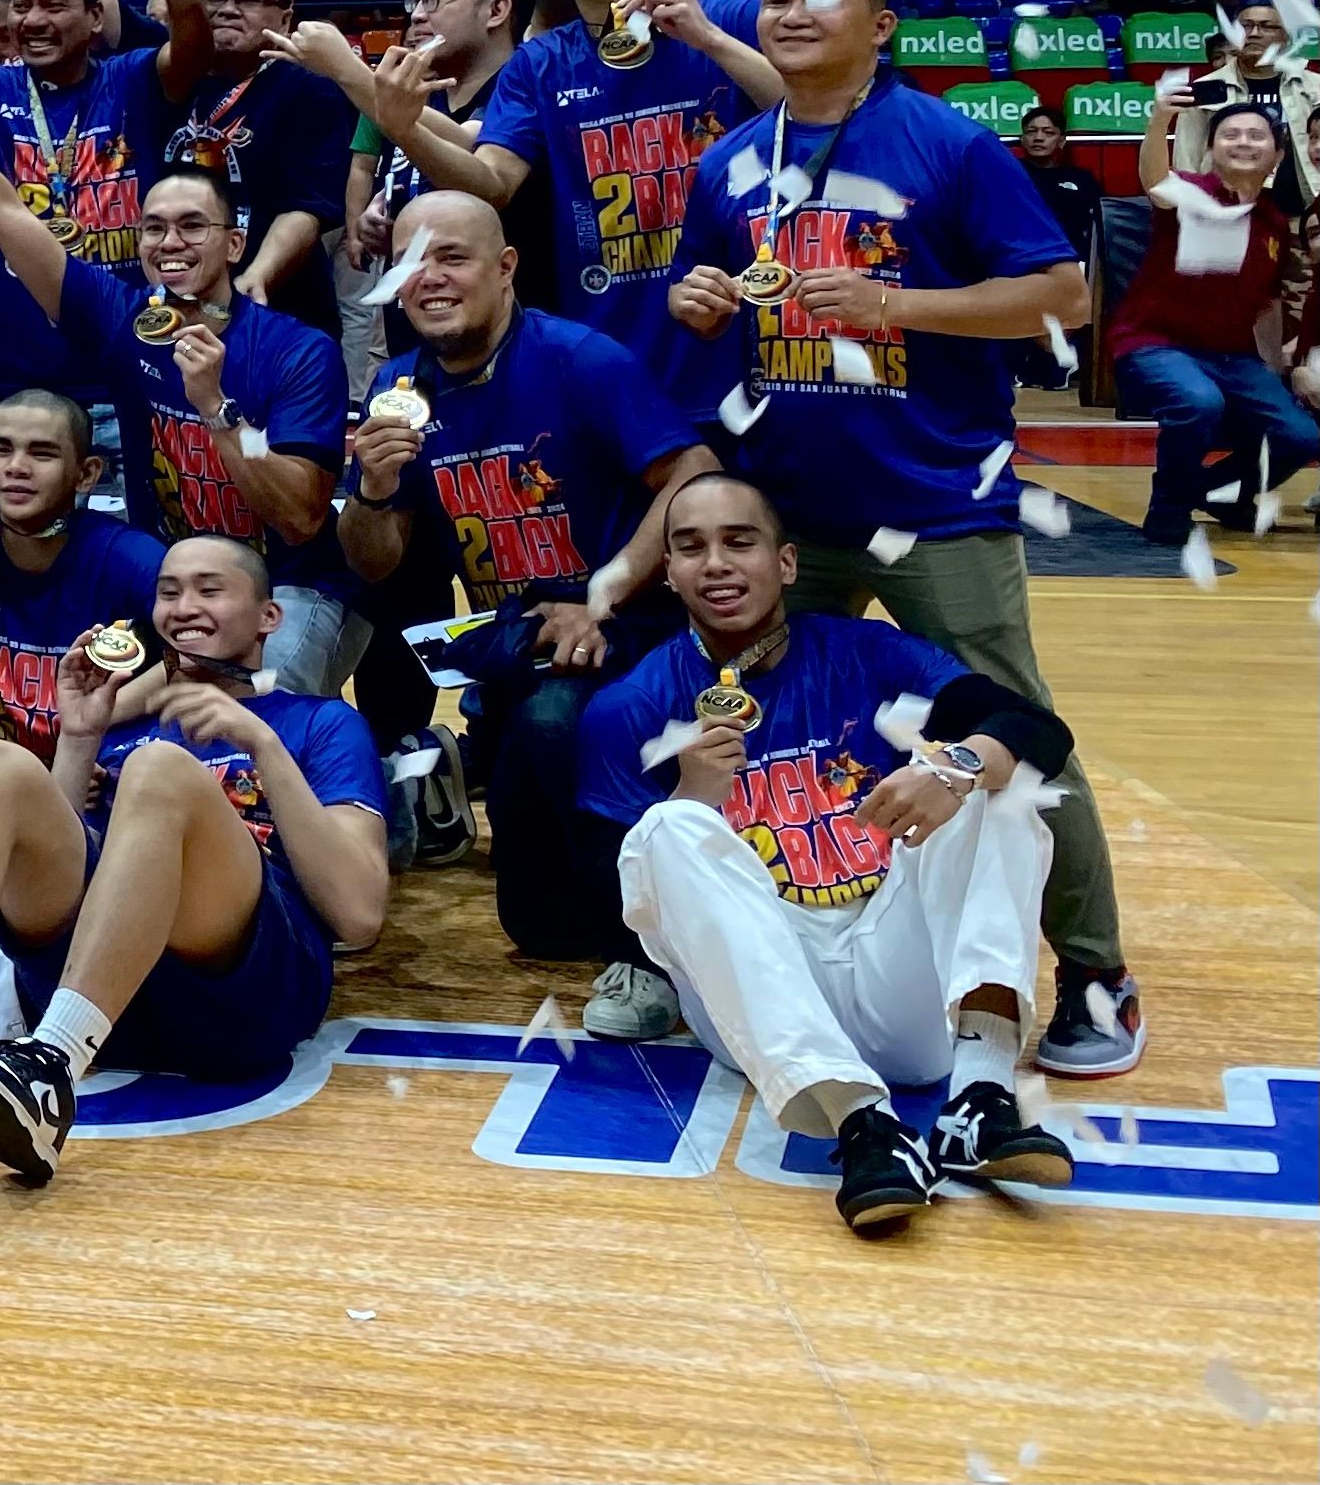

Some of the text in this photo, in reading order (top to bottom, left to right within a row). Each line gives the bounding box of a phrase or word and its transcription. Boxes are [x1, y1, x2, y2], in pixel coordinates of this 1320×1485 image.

[900, 29, 984, 54] nxled
[570, 86, 600, 100] TELA
[581, 111, 689, 183] BACK
[592, 172, 637, 239] 2
[742, 273, 780, 285] NCAA
[137, 313, 170, 326] NCAA
[433, 454, 525, 521] BACK
[454, 513, 589, 583] 2 BACK
[95, 632, 129, 652] NCAA
[701, 692, 744, 711] NCAA
